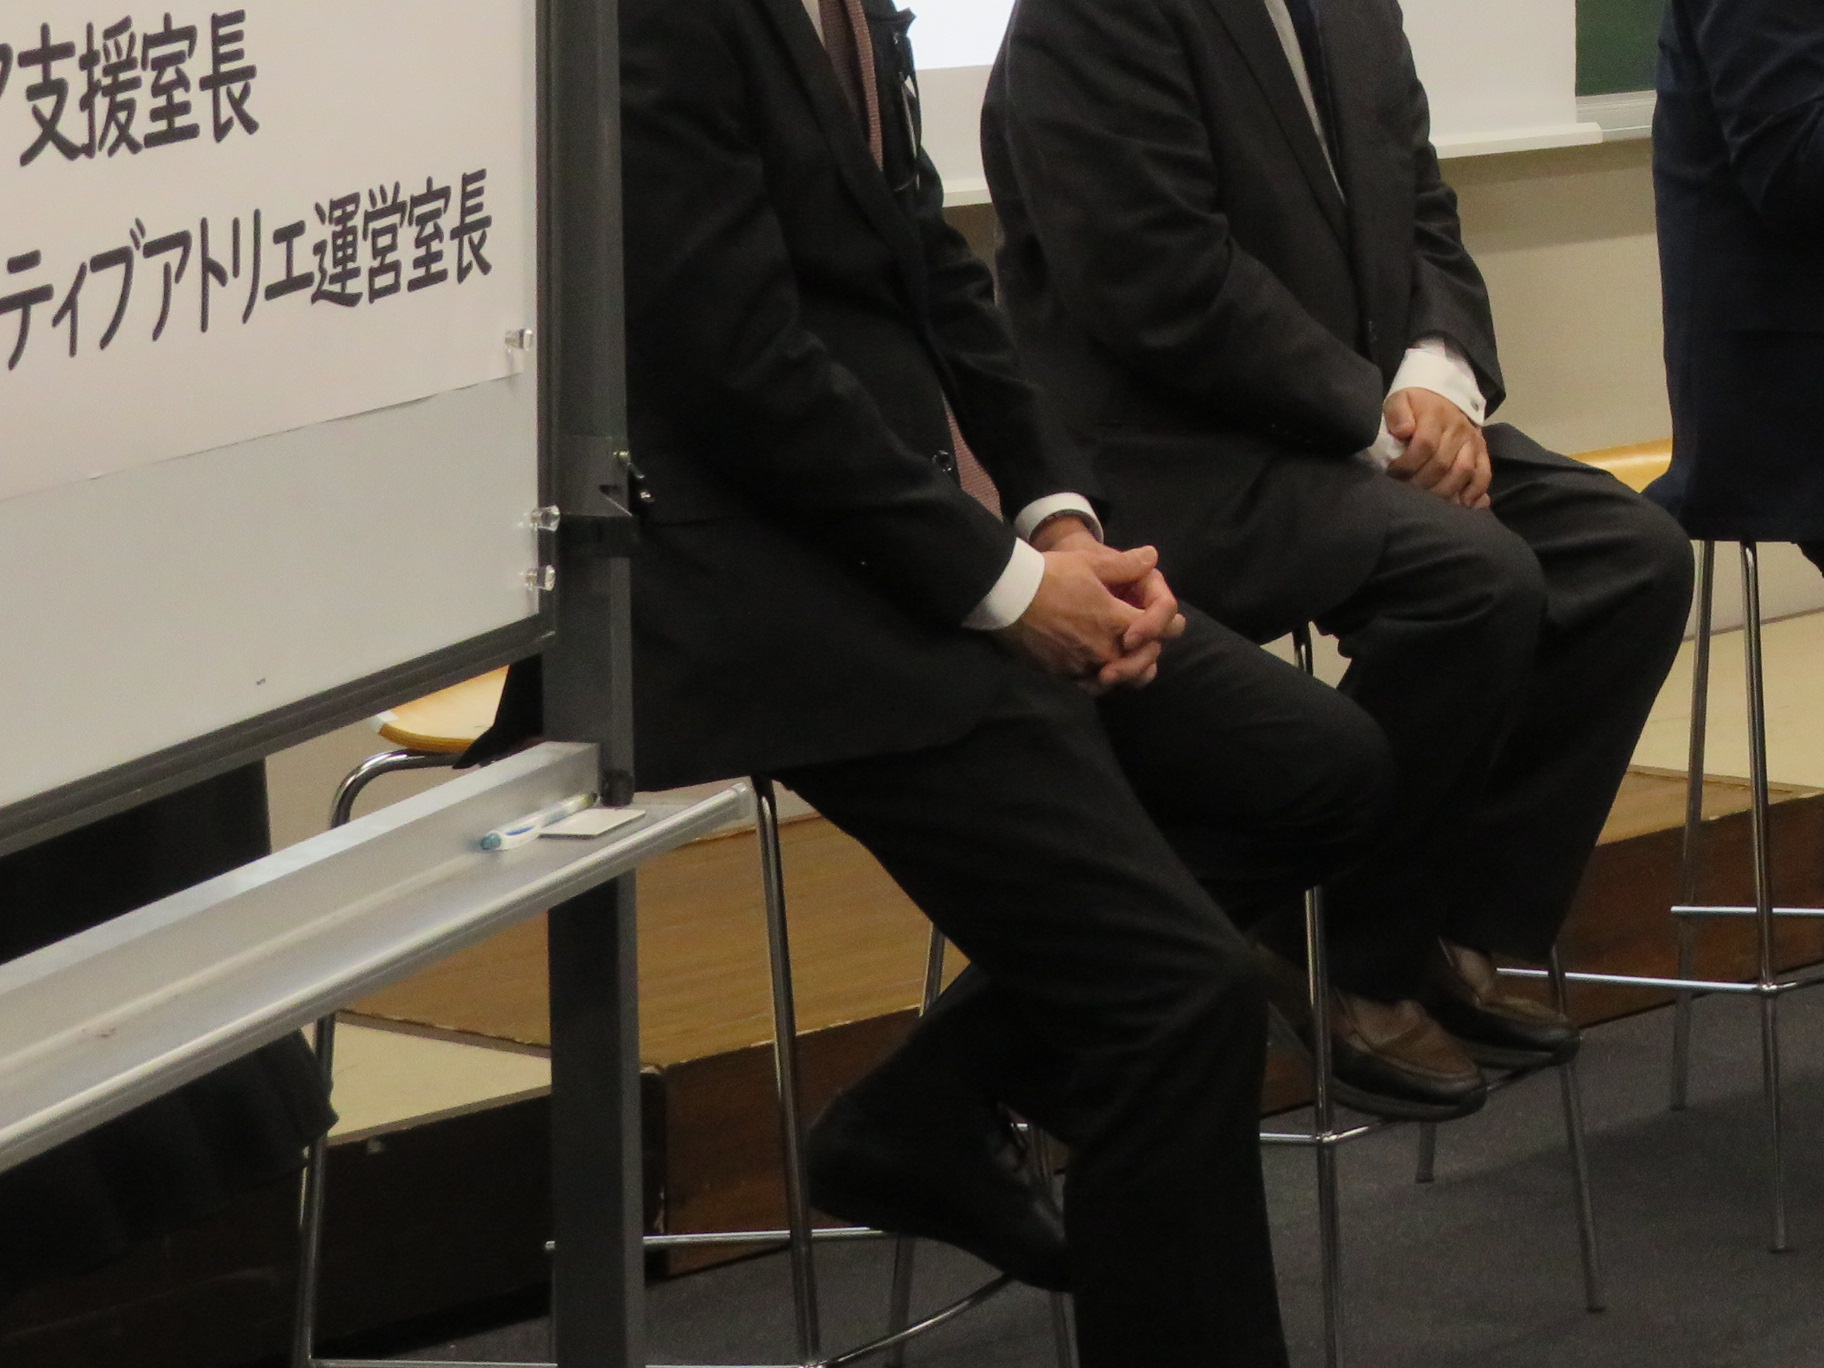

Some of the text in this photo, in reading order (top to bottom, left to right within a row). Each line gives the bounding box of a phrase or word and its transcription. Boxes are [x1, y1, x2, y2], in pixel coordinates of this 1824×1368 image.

[0, 8, 260, 167] 支援室長
[0, 167, 493, 372] ティブアトリエ運営室長
